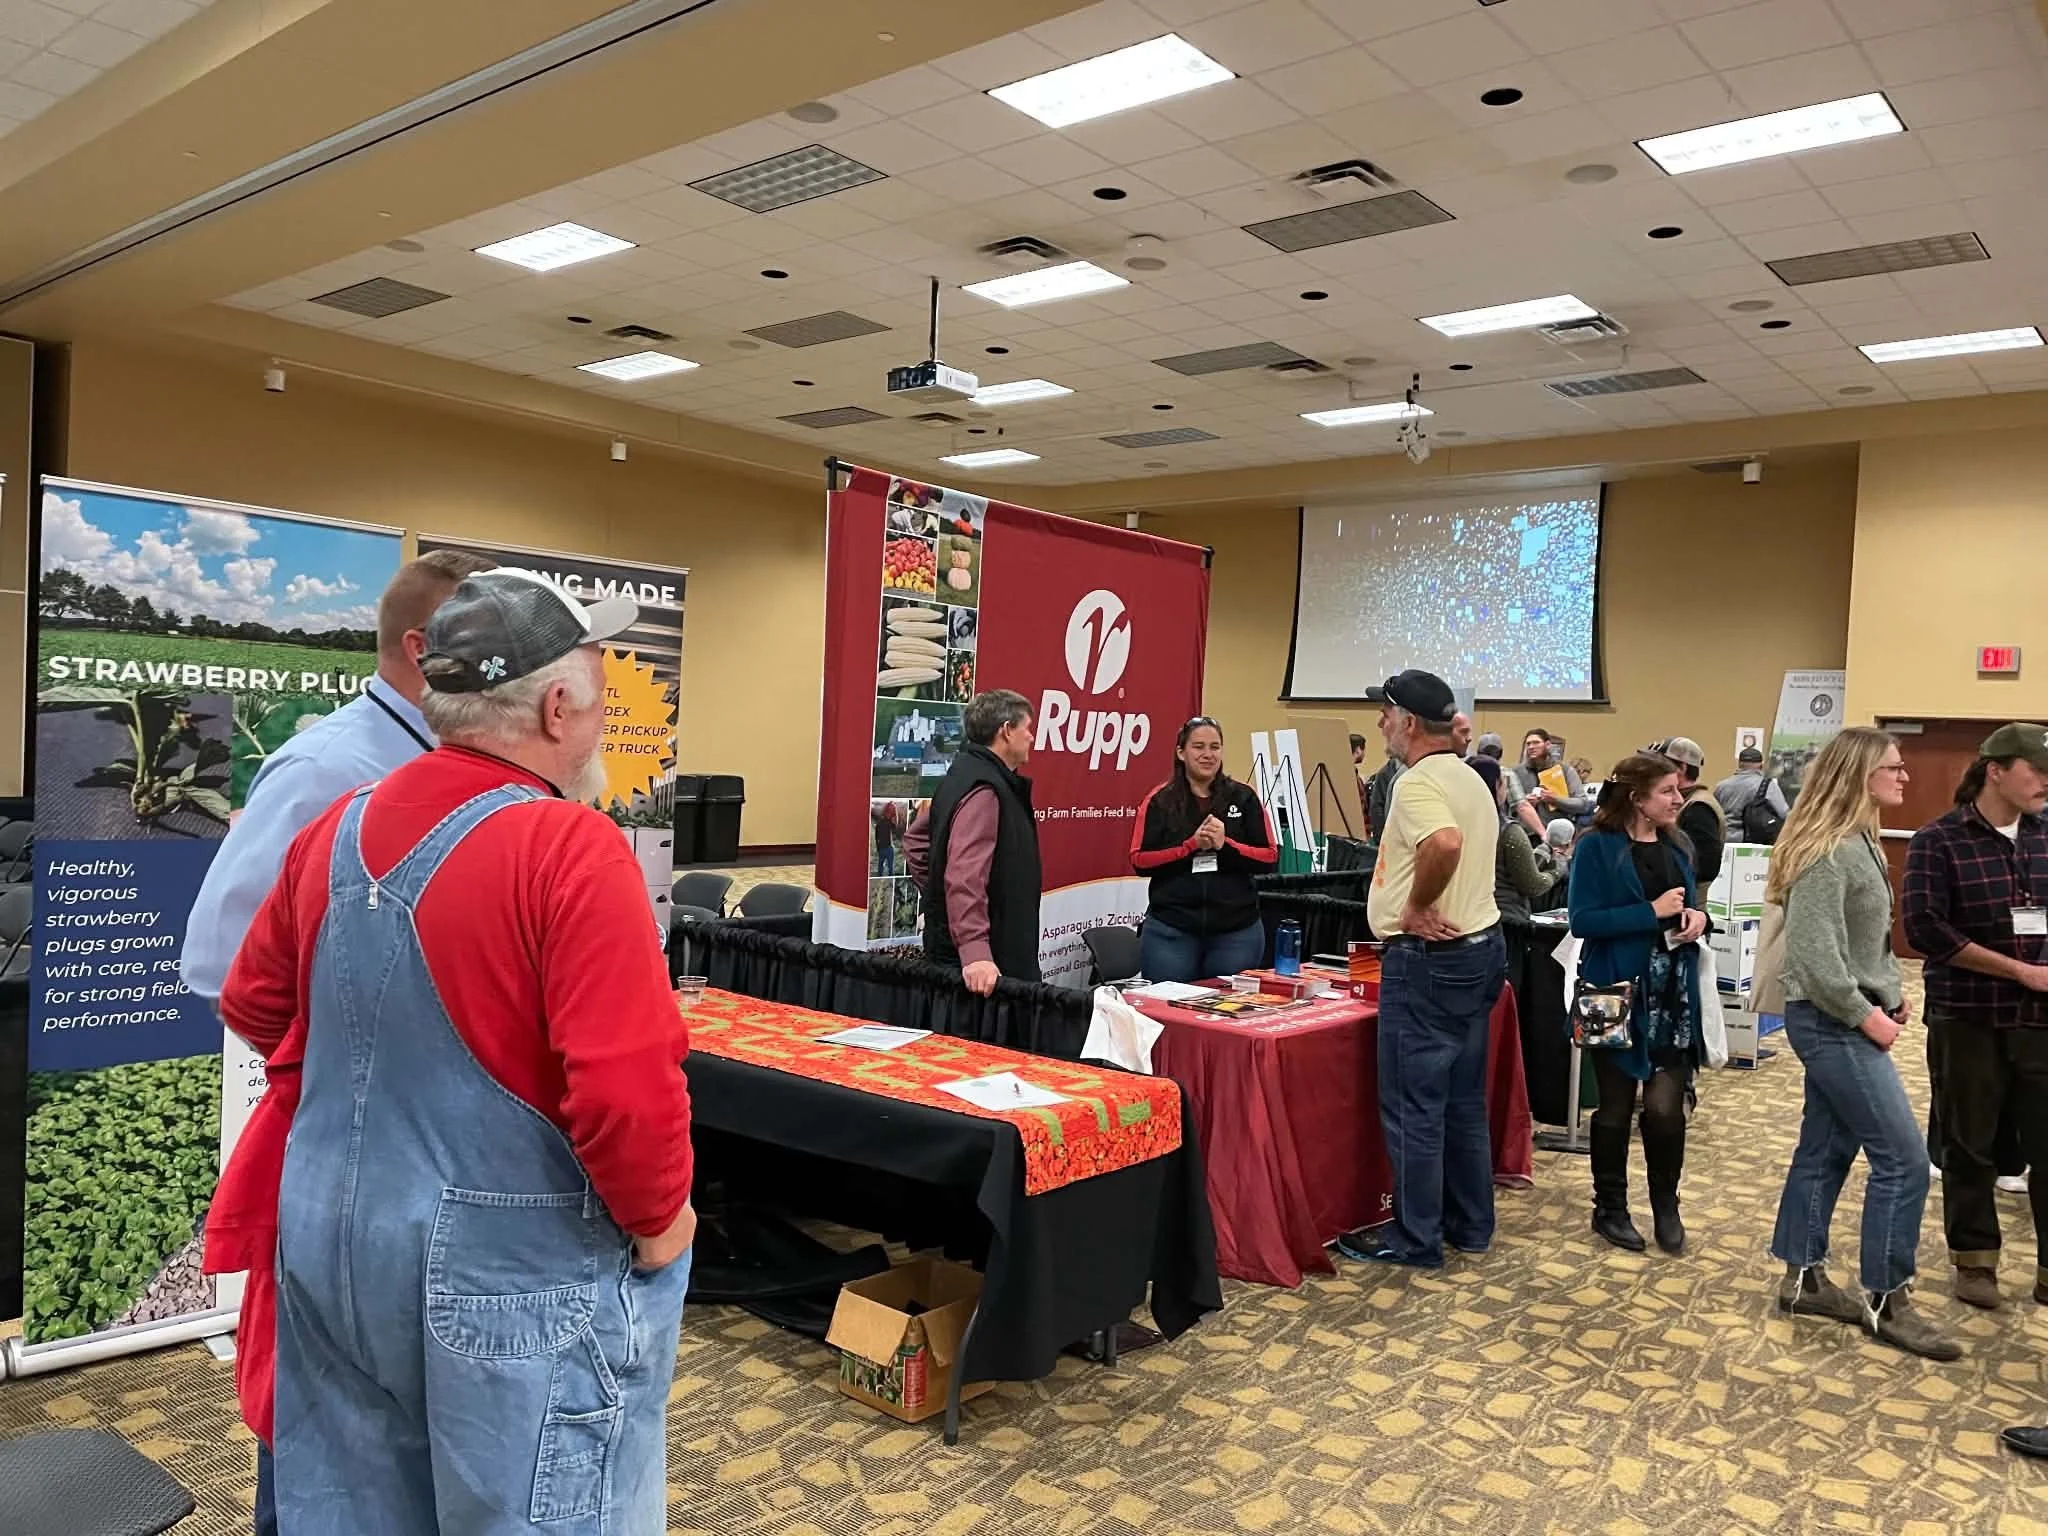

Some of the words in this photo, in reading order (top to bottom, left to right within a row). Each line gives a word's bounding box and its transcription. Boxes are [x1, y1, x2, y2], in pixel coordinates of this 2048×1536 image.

[594, 577, 676, 606] MADE
[48, 655, 290, 692] STRAWBERRY
[301, 672, 371, 695] PLU
[606, 687, 620, 698] TL
[604, 706, 631, 716] DEX
[603, 724, 618, 735] ER
[622, 726, 668, 736] PICKUP
[1034, 689, 1150, 771] Rupp
[600, 743, 614, 753] ER
[619, 744, 660, 754] TRUCK
[1033, 807, 1045, 821] ng
[1047, 806, 1069, 818] Farm
[1071, 806, 1102, 818] Families
[1103, 806, 1124, 818] Feed
[48, 859, 135, 878] Healthy,
[47, 886, 138, 905] vigorous
[45, 910, 161, 927] strawberry
[1042, 919, 1092, 940] Asparagus
[1095, 917, 1104, 928] to
[45, 936, 106, 956] plugs
[110, 935, 174, 954] grown
[1039, 950, 1047, 961] th
[1049, 941, 1087, 957] everything
[45, 962, 92, 978] with
[98, 962, 147, 976] care,
[1042, 960, 1072, 979] essional
[44, 988, 75, 1004] for
[78, 985, 146, 1002] strong
[43, 1007, 181, 1033] performance.
[248, 1059, 266, 1069] Co
